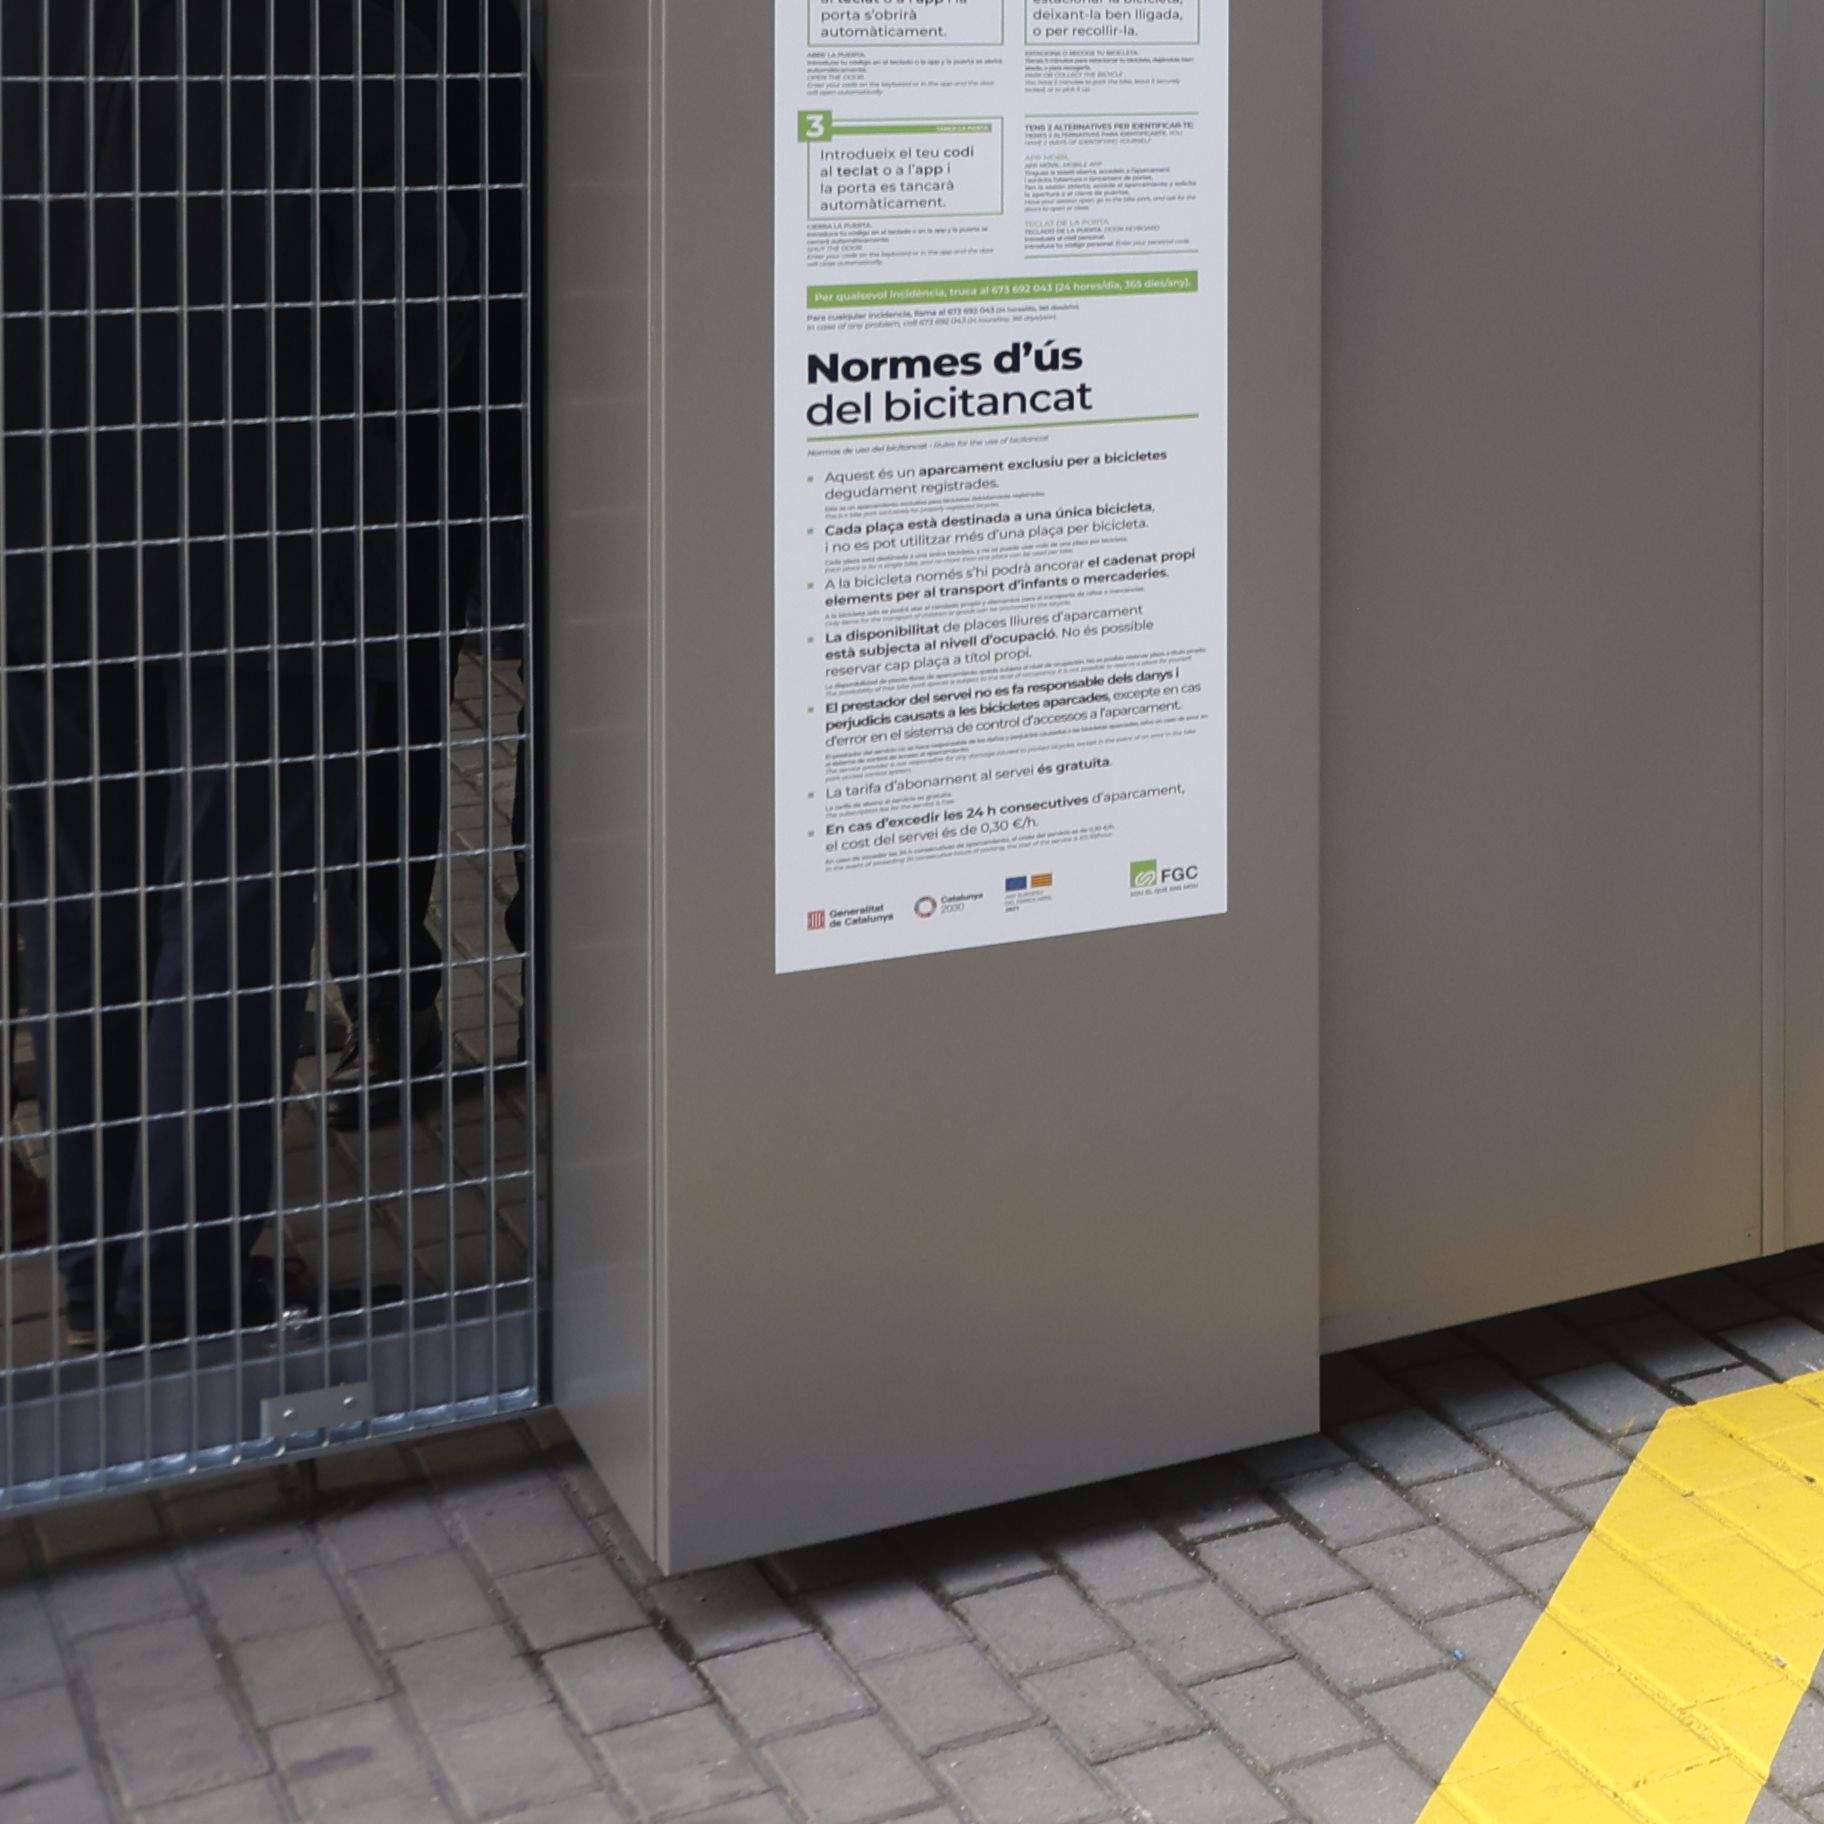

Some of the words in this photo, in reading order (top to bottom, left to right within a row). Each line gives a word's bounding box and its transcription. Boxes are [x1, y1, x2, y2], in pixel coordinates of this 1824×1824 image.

[821, 10, 860, 22] porta
[864, 9, 917, 20] s'obrirà
[1032, 9, 1101, 20] deixant-la
[1105, 9, 1131, 19] ben
[1045, 27, 1068, 38] per
[807, 352, 982, 384] Normes
[993, 339, 1083, 374] d'ús
[806, 391, 871, 426] del
[885, 382, 1092, 422] bicitancat
[825, 470, 873, 483] Aquest
[878, 469, 893, 479] és
[897, 469, 915, 477] un
[919, 461, 1003, 478] aparcament
[1007, 456, 1063, 470] exclusiu
[1067, 456, 1089, 469] per
[1104, 451, 1167, 464] bicicletes
[824, 484, 916, 501] degudament
[824, 523, 861, 536] Cada
[866, 521, 904, 535] plaça
[907, 517, 937, 529] està
[940, 512, 1010, 527] destinada
[1025, 511, 1051, 521] una
[1055, 506, 1092, 518] única
[826, 788, 841, 798] La
[845, 782, 881, 796] tarifa
[884, 772, 976, 791] d'abonament
[981, 769, 991, 780] al
[995, 767, 1033, 778] servei
[1037, 763, 1052, 774] és
[1161, 865, 1197, 883] FGC
[940, 893, 983, 903] Catalunya
[829, 904, 883, 917] Generalitat
[829, 919, 841, 927] de
[844, 913, 893, 926] Catalunya
